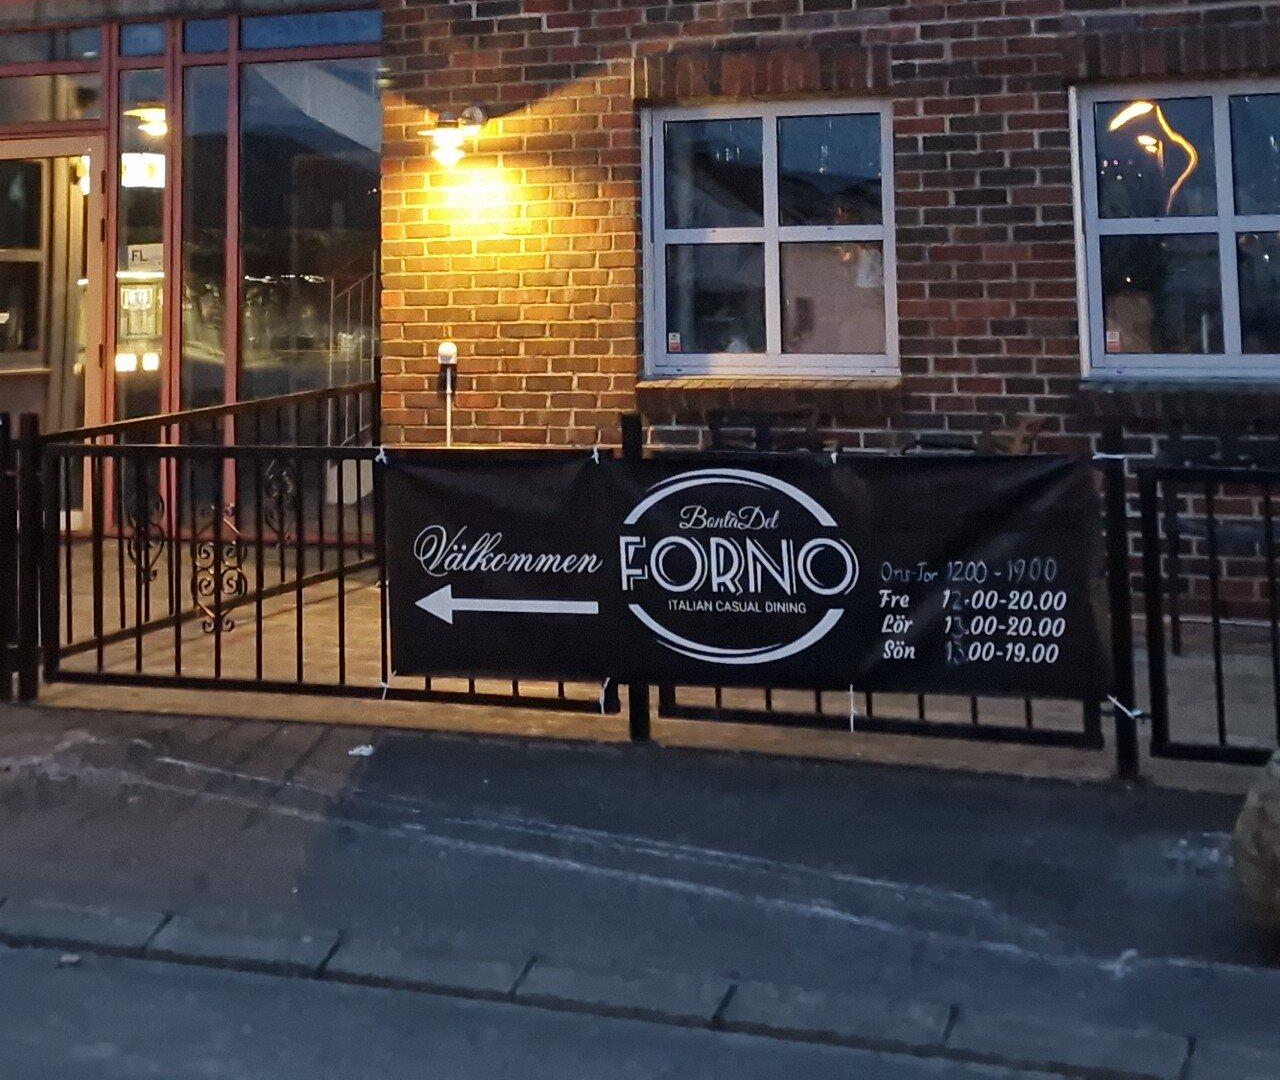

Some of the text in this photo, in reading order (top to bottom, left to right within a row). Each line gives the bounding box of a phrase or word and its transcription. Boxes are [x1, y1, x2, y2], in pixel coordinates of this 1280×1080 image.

[413, 524, 604, 577] Välkommen
[620, 535, 860, 596] FORNO
[668, 599, 807, 614] ITALIAN CASUAL DINING
[878, 589, 910, 609] Fre
[881, 613, 914, 634] Lör
[883, 639, 916, 660] Sön
